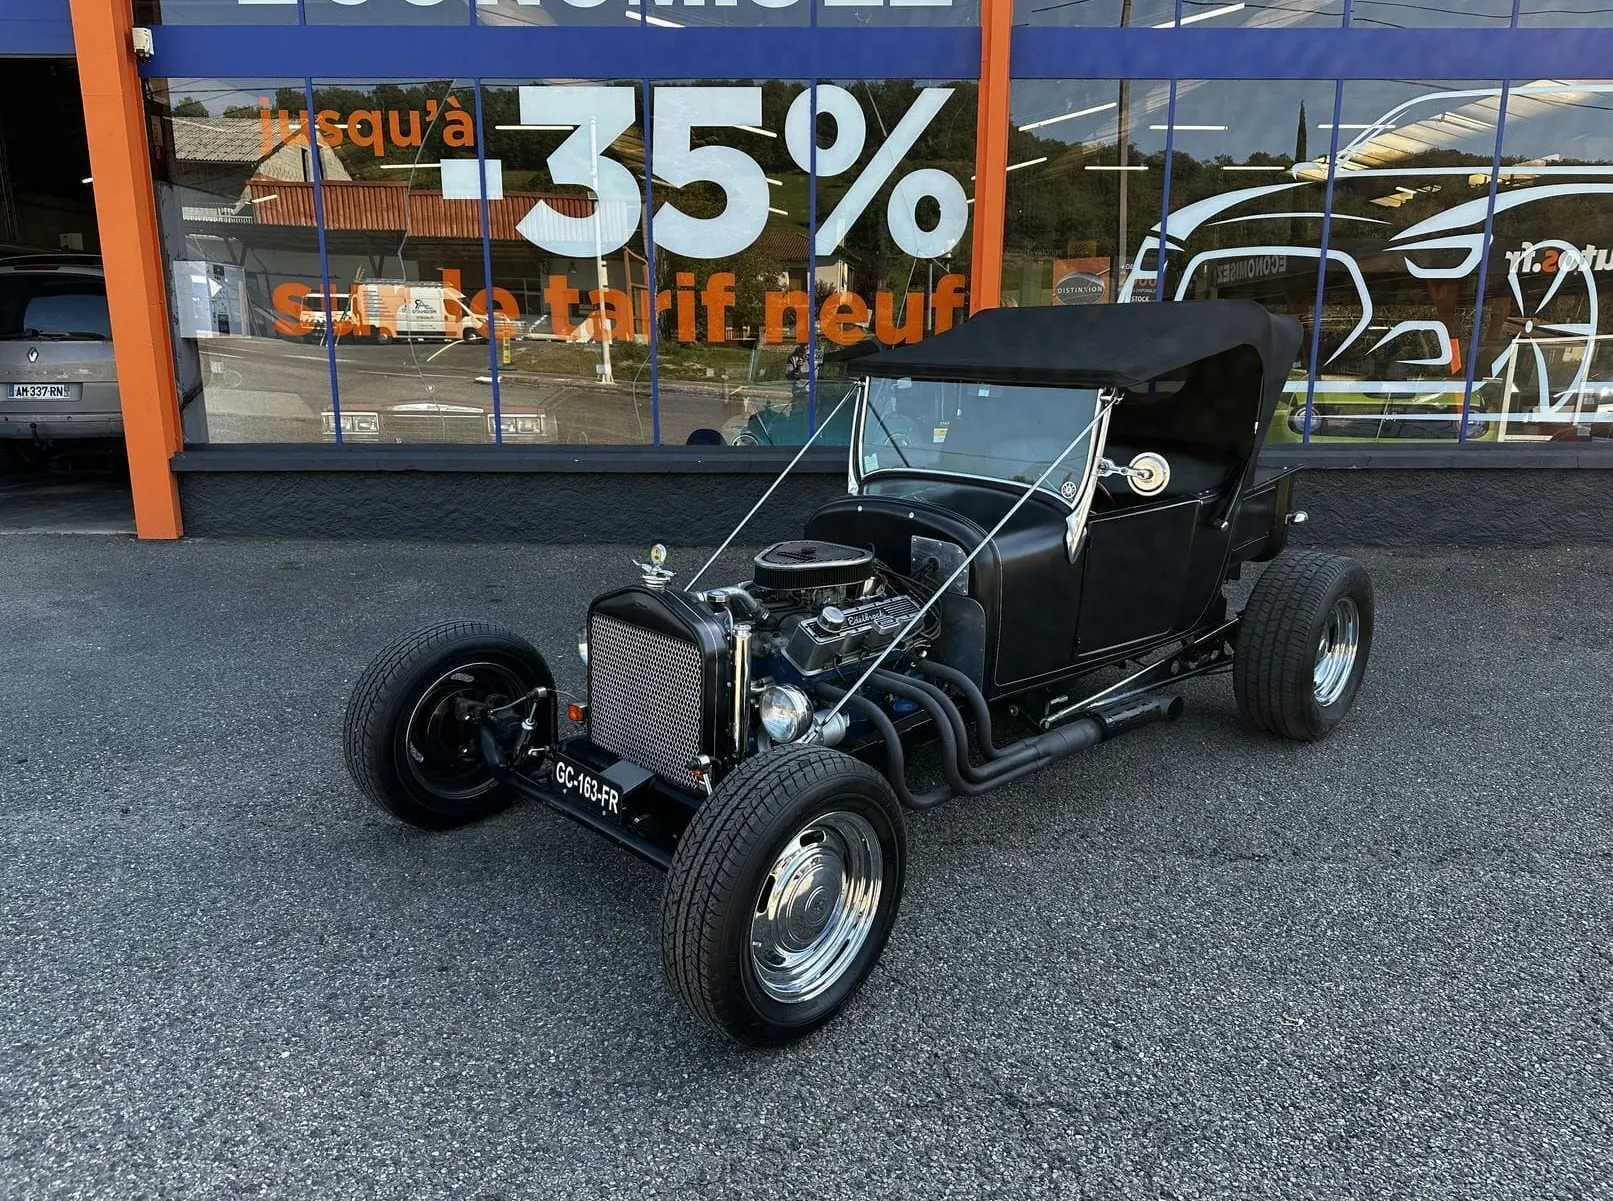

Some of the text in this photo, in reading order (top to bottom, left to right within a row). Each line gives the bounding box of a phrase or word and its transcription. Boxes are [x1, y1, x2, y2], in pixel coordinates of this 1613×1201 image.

[257, 95, 475, 158] jusqu'à
[440, 84, 969, 259] -35%
[442, 268, 520, 343] le
[544, 272, 736, 343] tarif
[765, 273, 966, 345] neuf
[1057, 285, 1103, 295] DISTINXION
[556, 761, 619, 814] GC-163-FR
